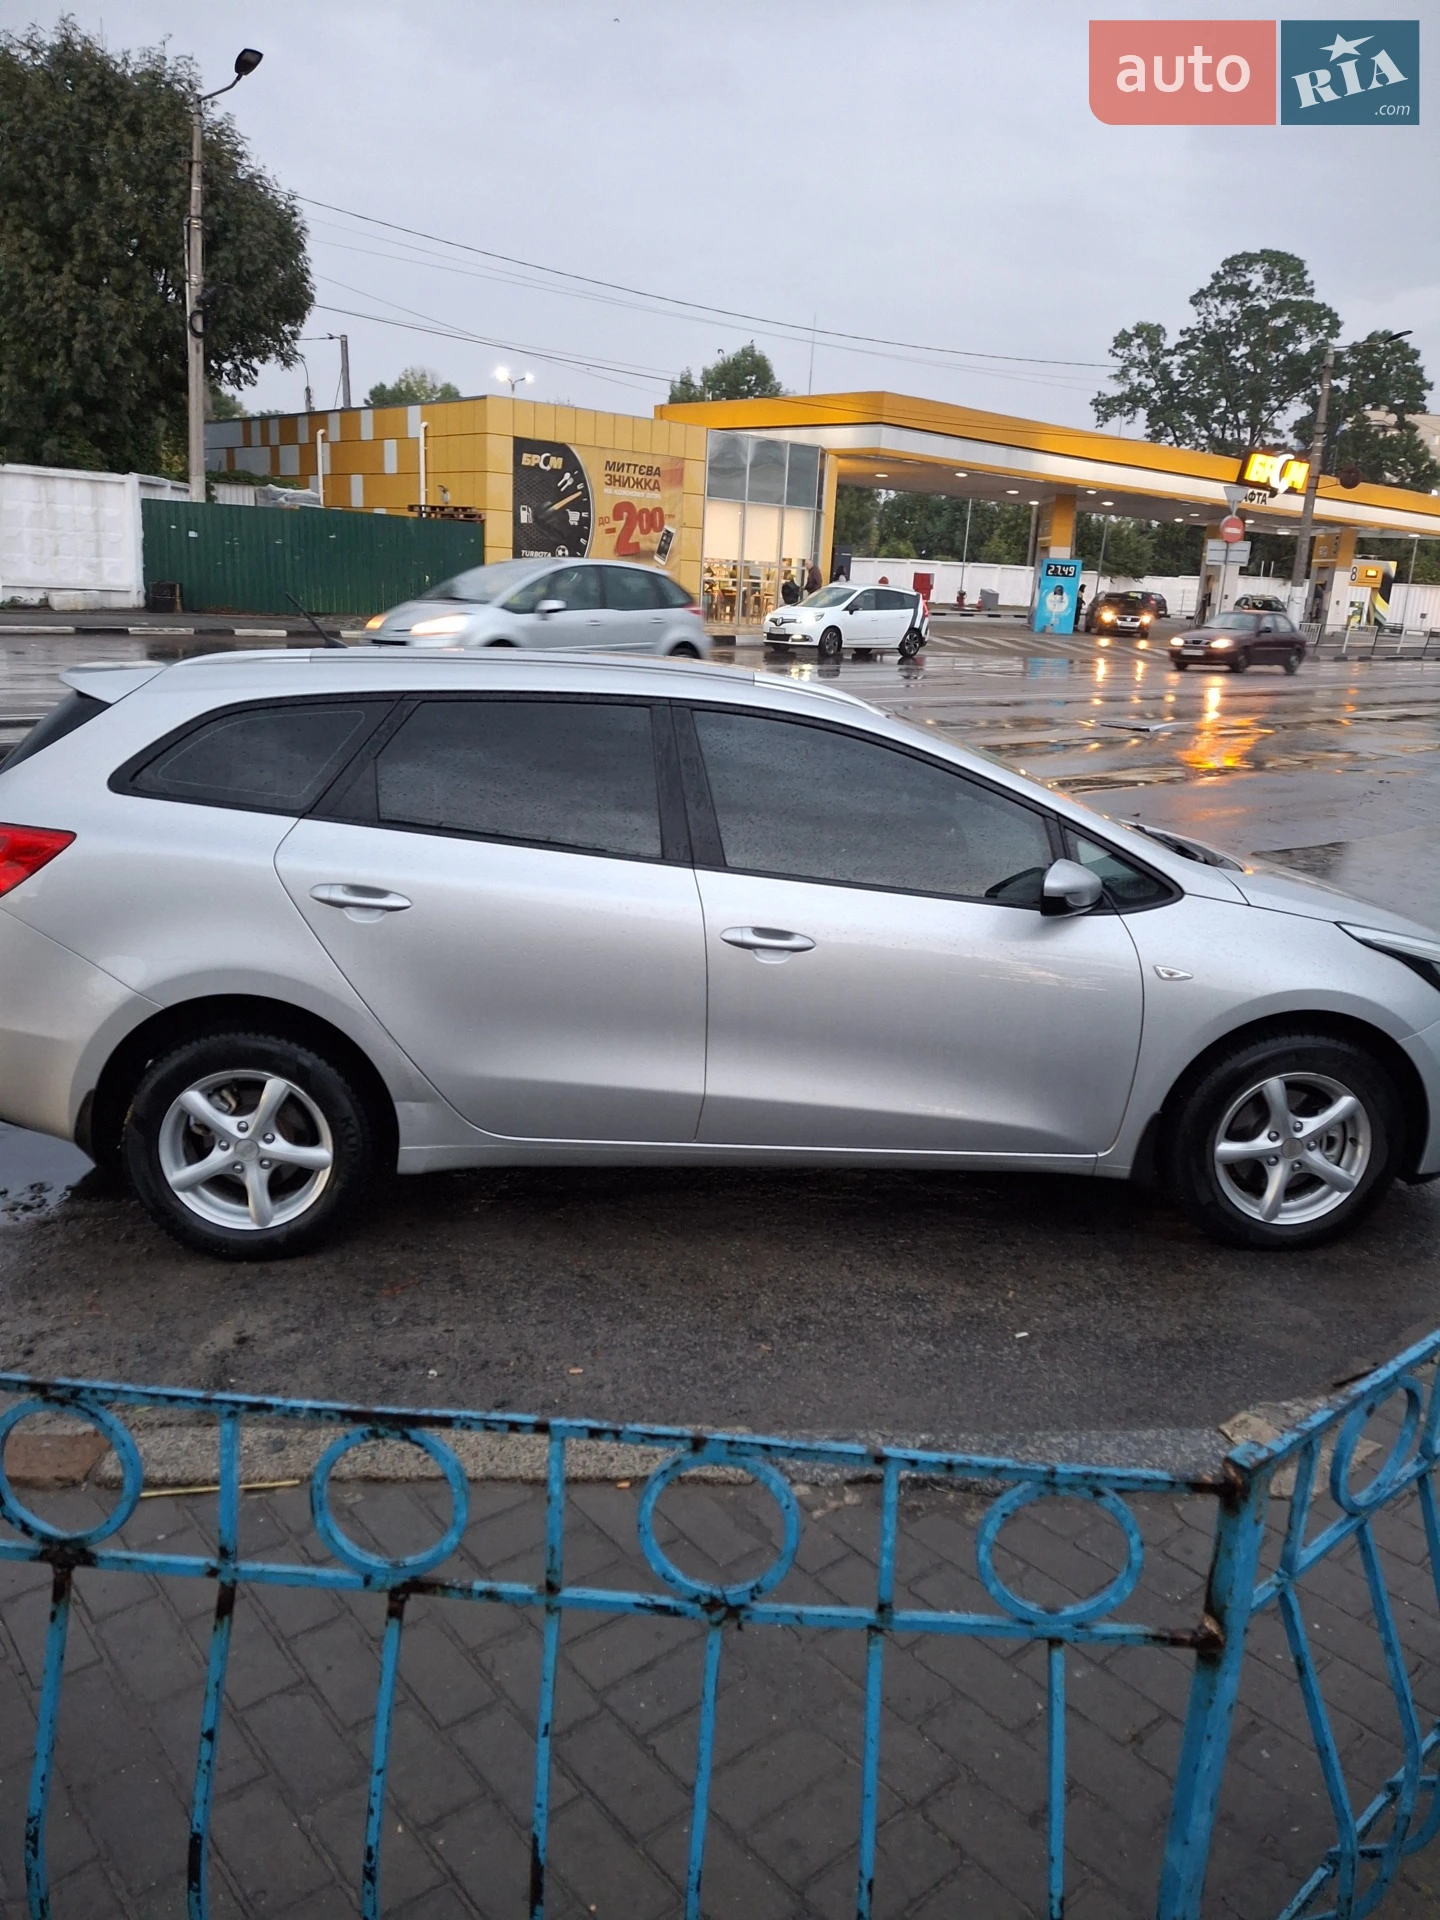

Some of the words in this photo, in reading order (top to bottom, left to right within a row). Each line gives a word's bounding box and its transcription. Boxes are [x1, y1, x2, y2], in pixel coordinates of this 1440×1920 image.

[521, 453, 563, 471] БРСМ
[604, 460, 661, 477] МИТТЄВА
[604, 473, 661, 492] ЗНИЖКА
[1243, 490, 1268, 505] АФТА
[521, 549, 552, 558] TURBOTA
[1350, 566, 1358, 581] 8
